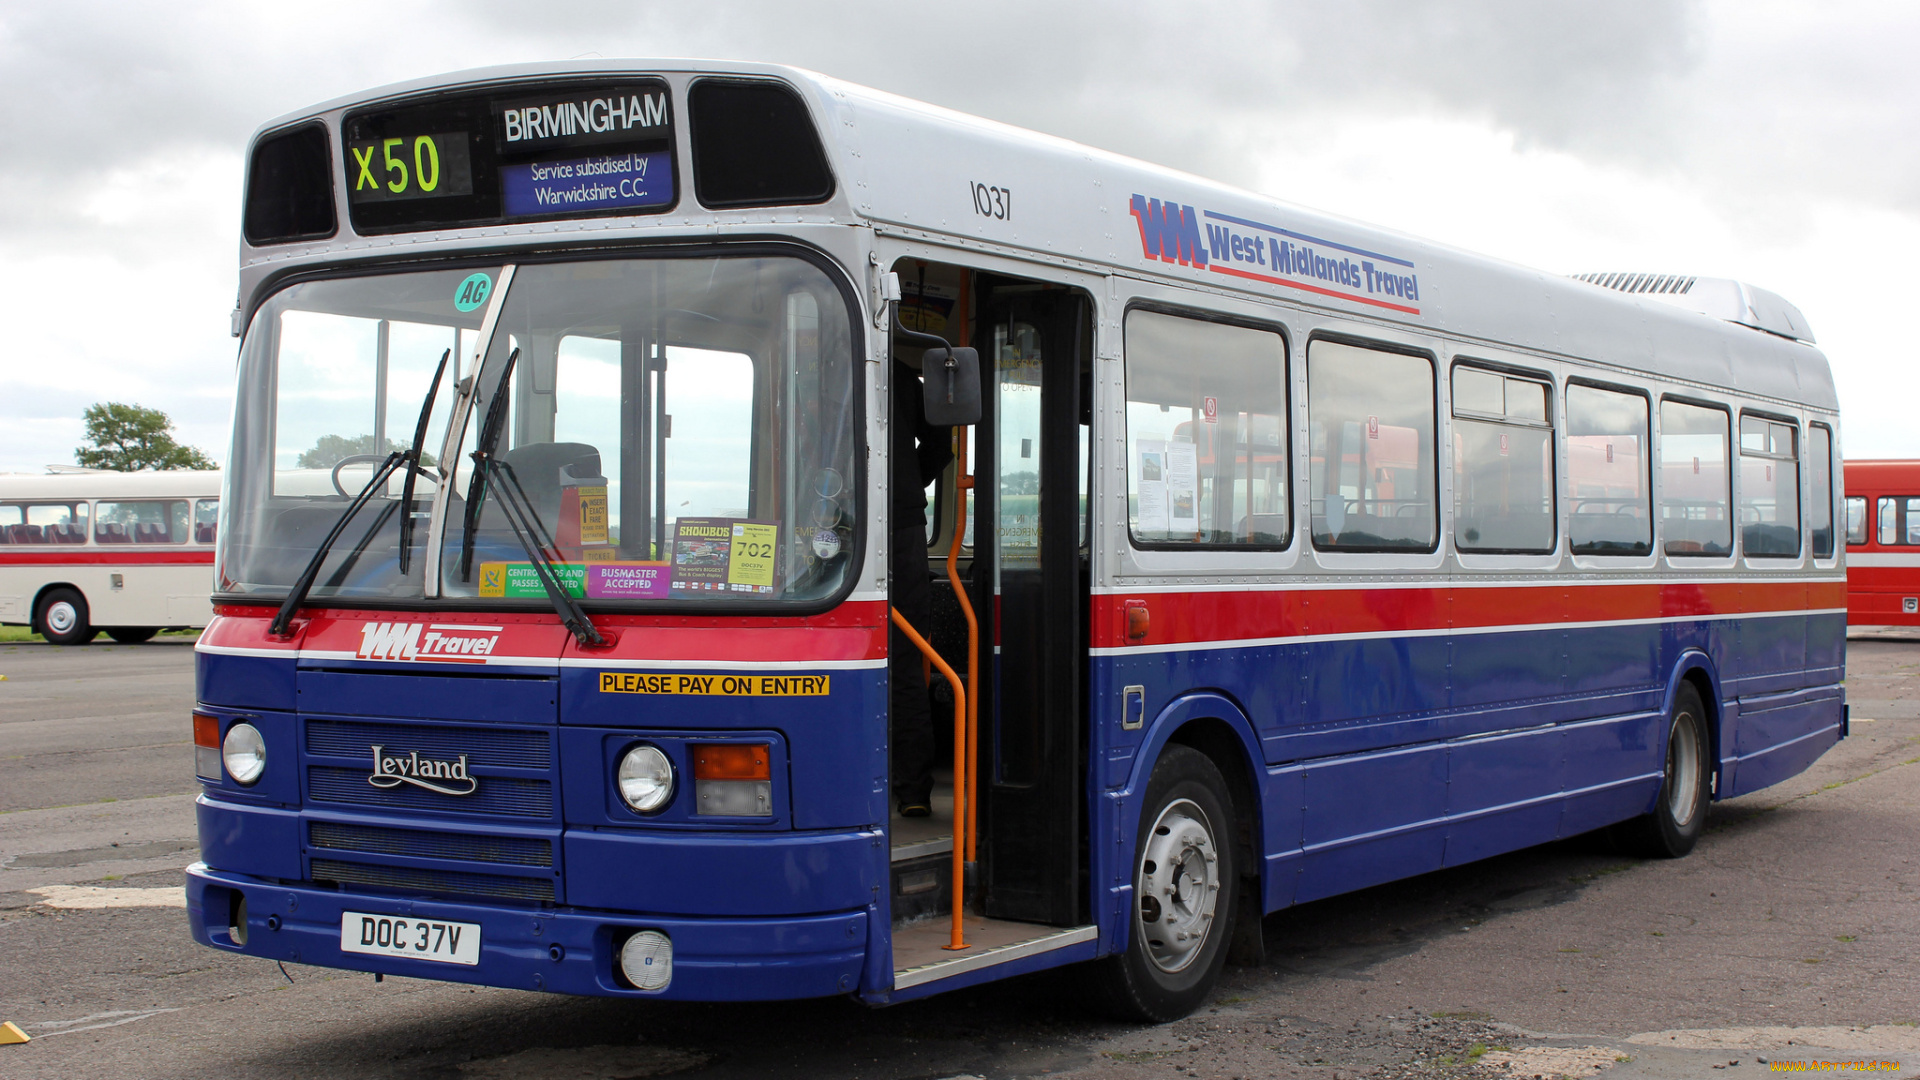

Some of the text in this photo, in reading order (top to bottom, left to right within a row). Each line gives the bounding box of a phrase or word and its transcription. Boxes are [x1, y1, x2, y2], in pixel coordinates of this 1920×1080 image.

[505, 92, 667, 141] BIRMINGHAM
[531, 153, 648, 181] Service subsidised by
[535, 178, 648, 206] Warwickshire C.C.
[970, 181, 1011, 221] 1037
[1206, 222, 1419, 301] West Midlands Travel
[459, 280, 487, 304] AG
[589, 507, 605, 515] EXACT
[679, 526, 730, 537] SHOWBUS
[588, 552, 611, 561] TICKET
[737, 541, 772, 559] 702
[511, 579, 539, 588] PASSES
[565, 569, 584, 578] AND
[601, 568, 658, 579] BUSMASTER
[604, 578, 652, 589] ACCEPTED
[421, 632, 499, 655] Travel
[602, 674, 826, 695] PLEASE PAY ON ENTRY
[368, 744, 478, 795] Leyland
[361, 917, 462, 955] DOC 37V
